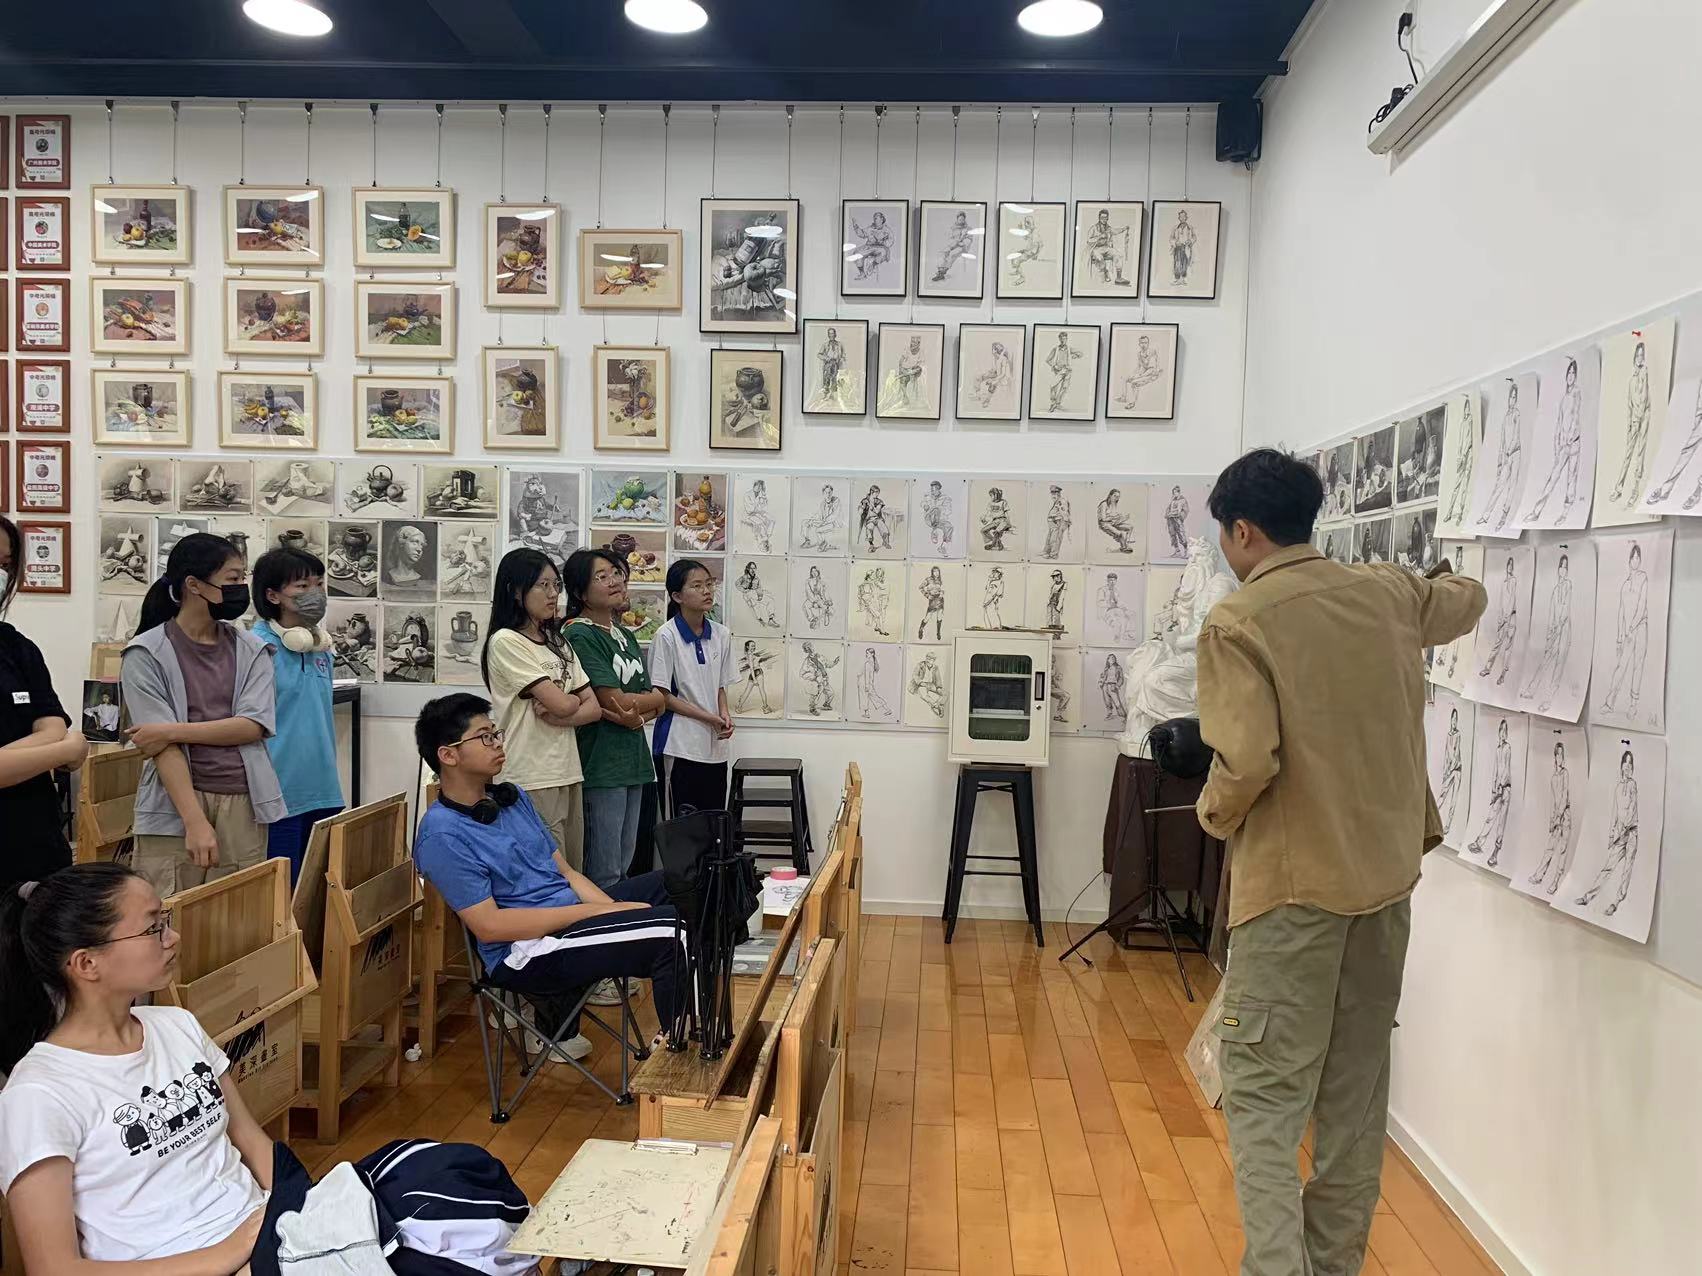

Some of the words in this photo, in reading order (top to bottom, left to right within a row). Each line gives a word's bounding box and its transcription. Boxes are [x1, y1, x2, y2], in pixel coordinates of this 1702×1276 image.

[157, 1146, 170, 1158] BE
[170, 1134, 192, 1150] YOUR
[189, 1126, 206, 1139] BEST
[207, 1112, 222, 1128] SELF
